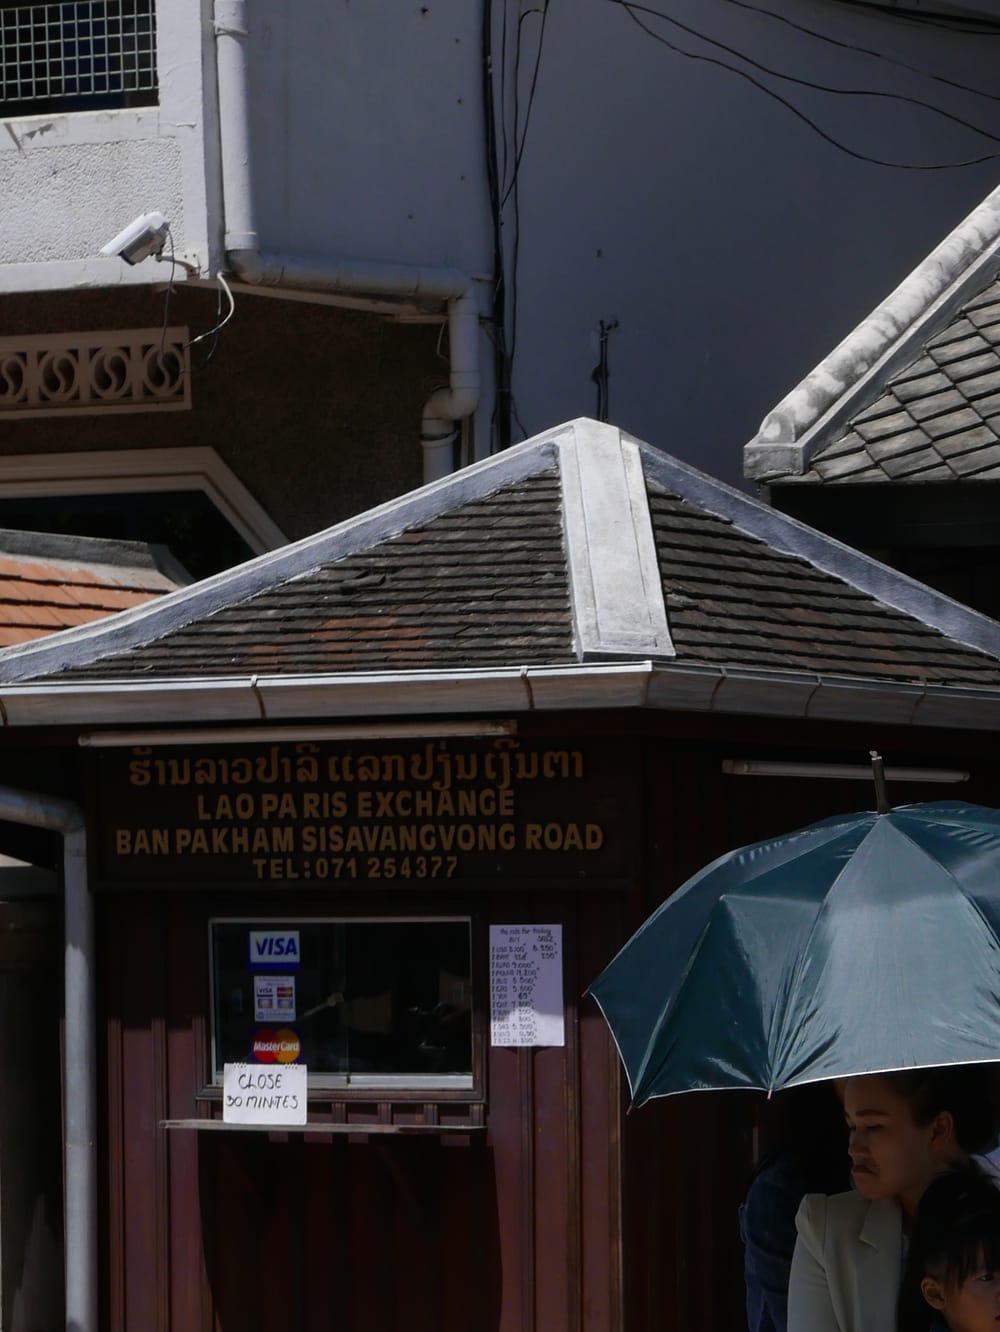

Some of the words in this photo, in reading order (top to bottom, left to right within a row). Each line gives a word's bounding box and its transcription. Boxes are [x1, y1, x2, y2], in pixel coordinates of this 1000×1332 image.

[197, 792, 255, 821] LAO
[261, 791, 348, 820] PARIS
[356, 788, 515, 818] EXCHANGE
[115, 828, 169, 855] BAN
[175, 826, 294, 855] PAKHAM
[301, 823, 516, 853] SISAVANGVONG
[524, 823, 604, 850] ROAD
[367, 856, 458, 879] 254377
[255, 937, 297, 956] VISA
[253, 1040, 300, 1052] MasterCard
[238, 1073, 283, 1090] CLOSE
